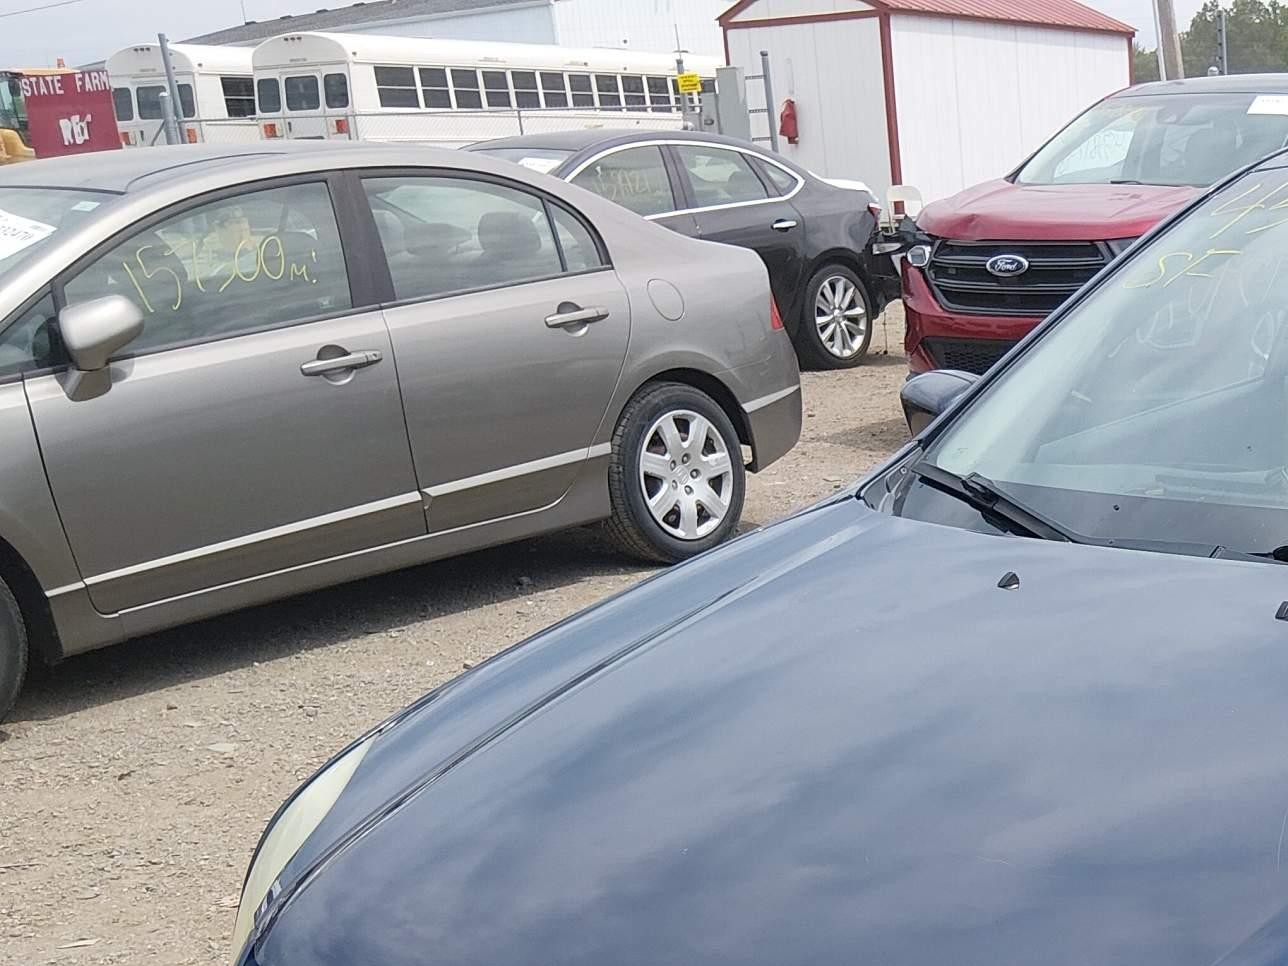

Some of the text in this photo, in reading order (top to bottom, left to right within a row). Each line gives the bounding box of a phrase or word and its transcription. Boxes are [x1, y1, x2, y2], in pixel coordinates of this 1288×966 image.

[21, 71, 110, 97] STATE FARM
[995, 259, 1018, 271] Ford
